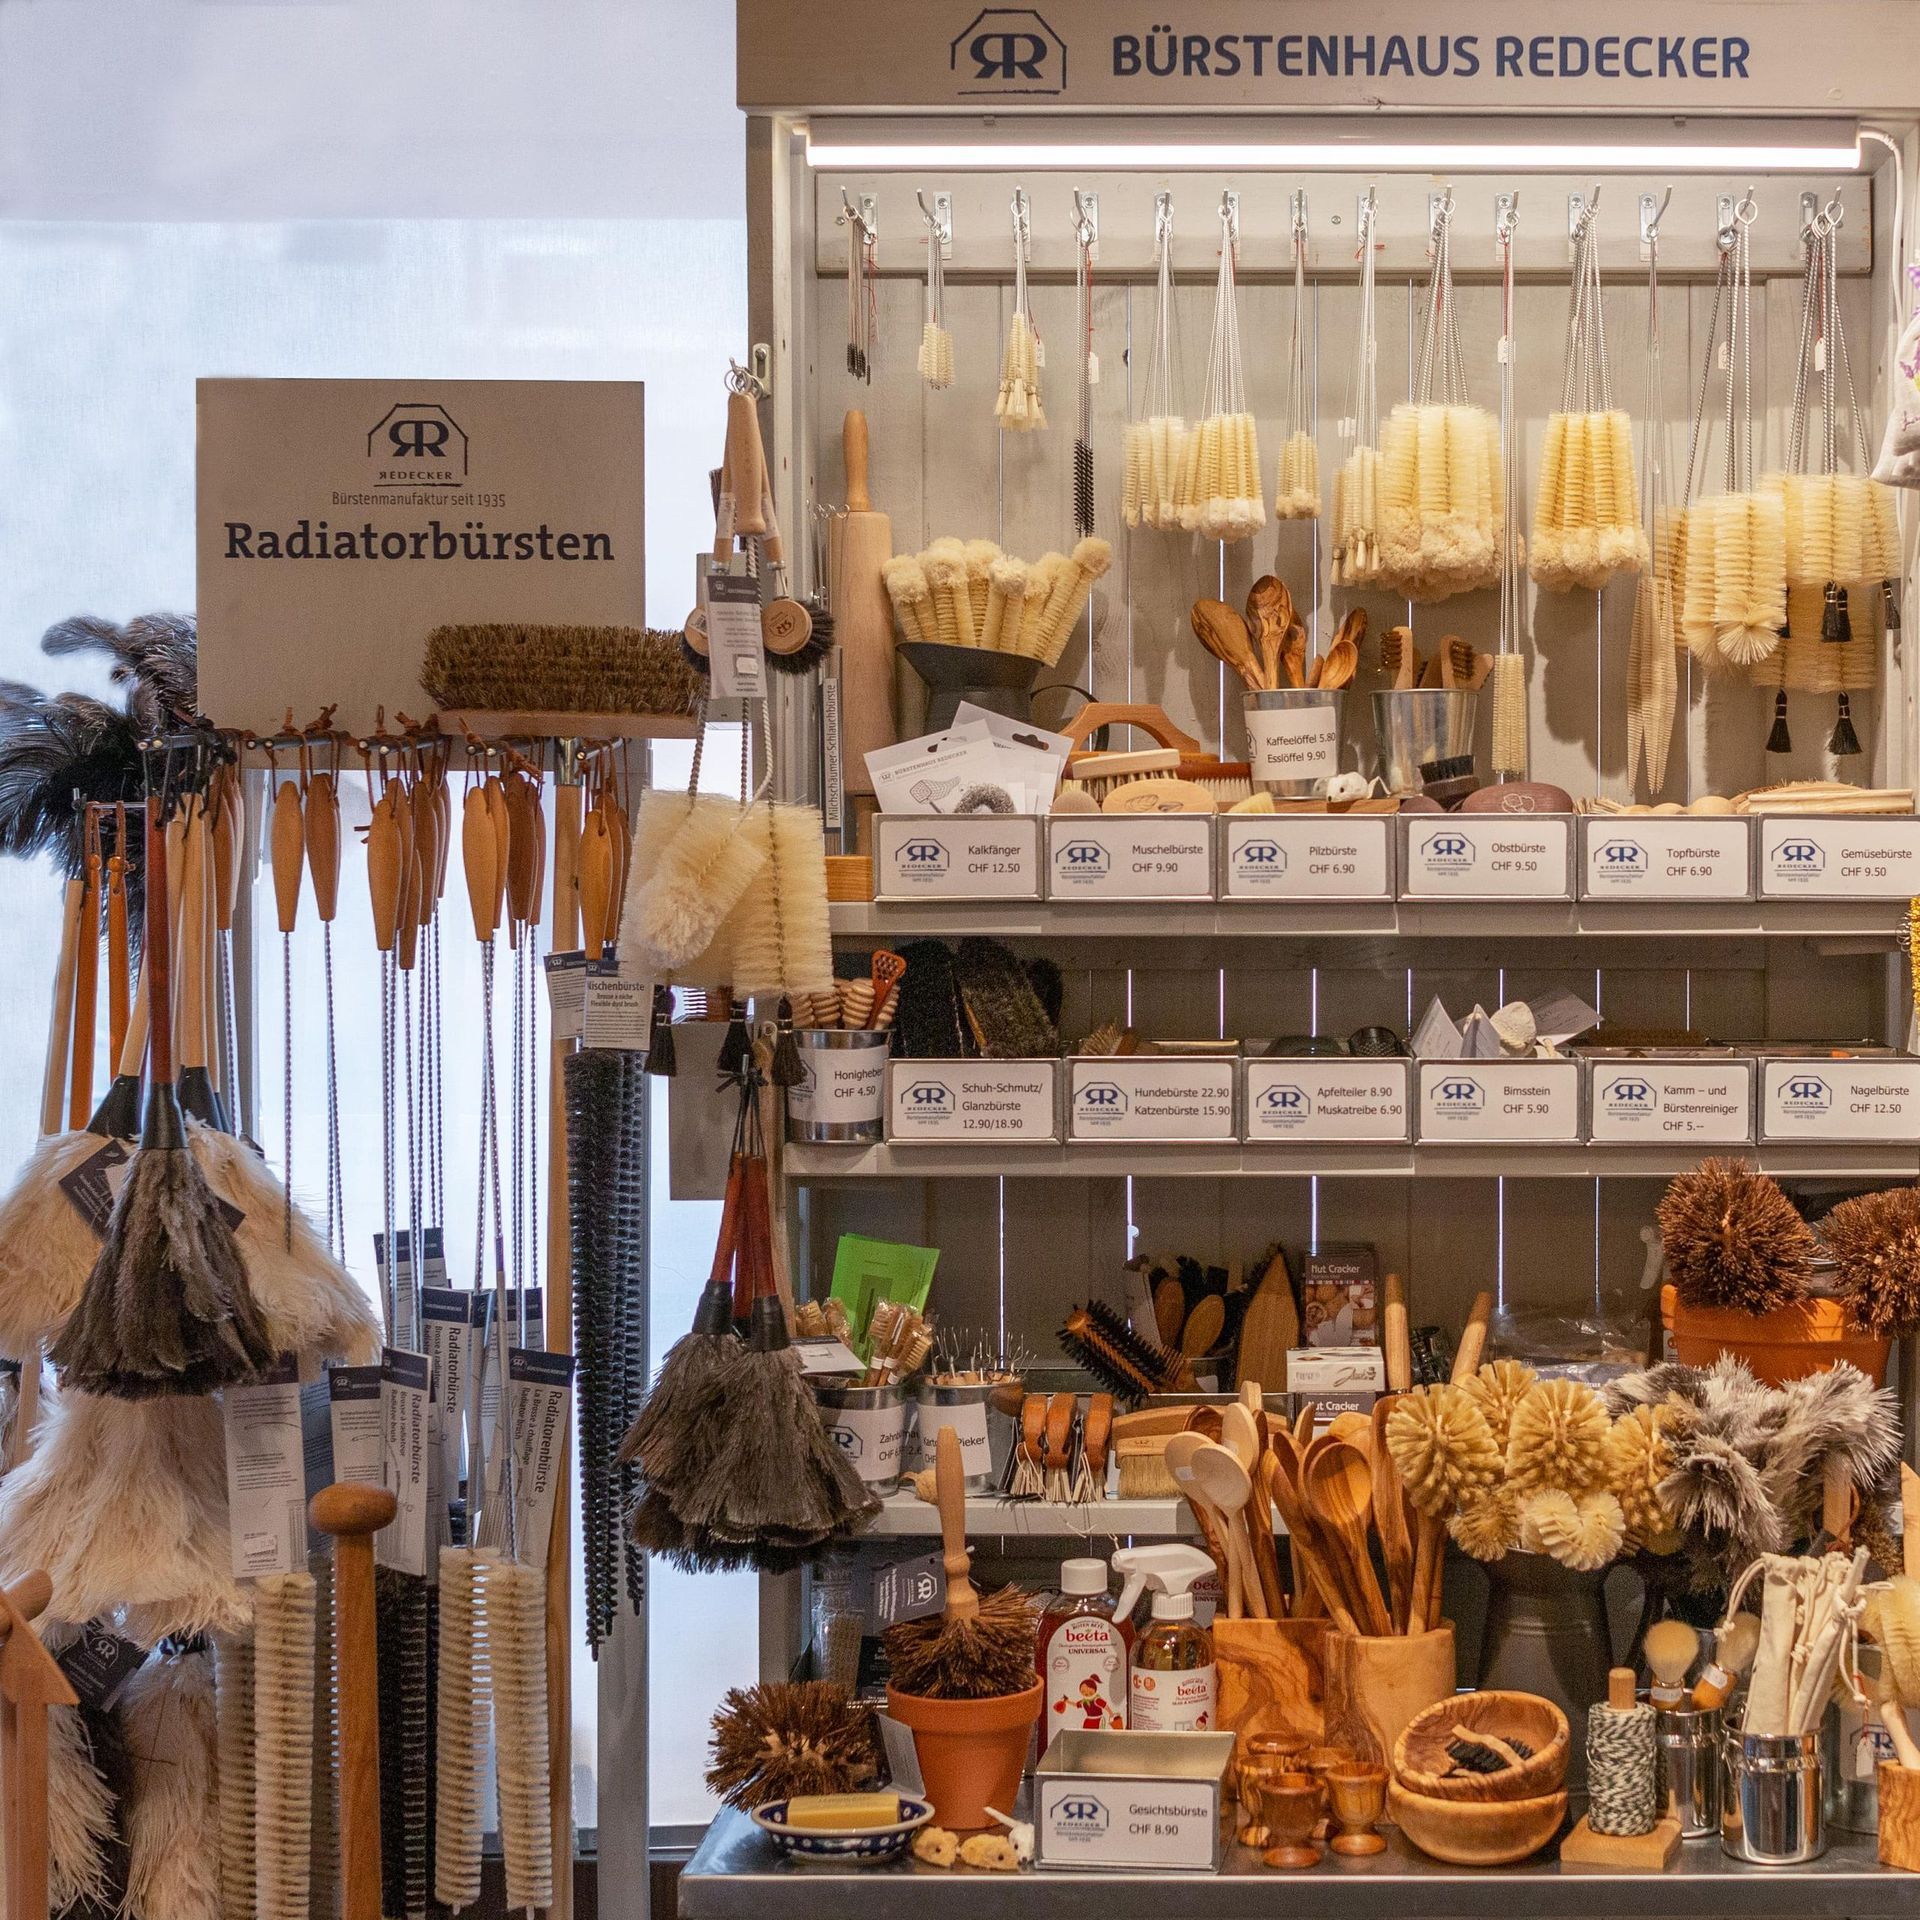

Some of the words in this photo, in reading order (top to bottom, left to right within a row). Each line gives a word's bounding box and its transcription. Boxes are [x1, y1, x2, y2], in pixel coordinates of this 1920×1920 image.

[1112, 25, 1479, 78] BÜRSTENHAUS
[1497, 36, 1750, 79] REDECKER
[379, 471, 453, 480] REDECKER
[332, 491, 449, 507] Bürstenmanufaktur
[451, 493, 474, 506] seit
[478, 494, 505, 508] 1935
[224, 520, 615, 561] Radiatorbürsten
[1266, 732, 1316, 747] Kaffeelöffel
[1319, 732, 1336, 743] 5.80
[1267, 751, 1305, 763] Esslöffel
[1307, 751, 1326, 762] 9.90
[968, 844, 1021, 857] Kalkfänger
[1132, 844, 1203, 855] Muschelbürste
[1309, 846, 1357, 856] Pilzbürste
[1491, 843, 1546, 853] Obstbürste
[1667, 848, 1720, 860] Topfbürste
[1841, 848, 1912, 860] Gemüsebürste
[968, 863, 988, 873] CHF
[992, 863, 1020, 873] 12.50
[1132, 863, 1153, 873] CHF
[1156, 863, 1178, 873] 9.90
[1309, 864, 1330, 874] CHF
[1333, 864, 1355, 874] 6.90
[1491, 861, 1512, 871] CHF
[1515, 861, 1537, 871] 9.50
[1667, 866, 1687, 876] CHF
[1690, 866, 1712, 876] 6.90
[1841, 867, 1861, 877] CHF
[1865, 867, 1887, 877] 9.50
[834, 1067, 884, 1081] Honigheber
[834, 1088, 854, 1098] CHF
[857, 1086, 876, 1096] 4.50
[962, 1081, 1043, 1094] Schuh-Schmutz/
[1135, 1086, 1198, 1097] Hundebürste
[1201, 1088, 1229, 1097] 22.90
[1317, 1086, 1367, 1099] Apfelteiler
[1370, 1087, 1392, 1097] 8.90
[1504, 1086, 1551, 1096] Bimsstein
[1664, 1086, 1695, 1095] Kamm
[1708, 1086, 1727, 1095] und
[1850, 1085, 1909, 1097] Nagelbürste
[962, 1100, 1021, 1111] Glanzbürste
[1135, 1105, 1199, 1116] Katzenbürste
[1203, 1106, 1230, 1116] 15.90
[1317, 1105, 1377, 1115] Muskatreibe
[1380, 1105, 1402, 1115] 6.90
[1503, 1104, 1524, 1114] CHF
[1527, 1104, 1549, 1114] 5.90
[1663, 1103, 1738, 1116] Bürstenreiniger
[1850, 1104, 1870, 1113] CHF
[1874, 1104, 1901, 1113] 12.50
[963, 1119, 1023, 1129] 12.90/18.90
[1663, 1121, 1683, 1131] CHF
[1311, 1265, 1326, 1273] Nut
[1328, 1264, 1360, 1274] Cracker
[434, 1326, 442, 1349] Brosse
[447, 1327, 461, 1413] Radiatorbürste
[518, 1387, 531, 1418] Radiator
[1326, 1401, 1359, 1411] Cracker
[530, 1399, 541, 1422] Brosse
[411, 1393, 422, 1484] Radiatorbürste
[535, 1390, 562, 1493] Radiatorenbürste
[1066, 1628, 1108, 1641] beeta
[1177, 1685, 1207, 1696] beeta
[1129, 1803, 1208, 1818] Gesichtsbürste
[1129, 1824, 1151, 1834] CHF
[1154, 1824, 1179, 1836] 8.90
